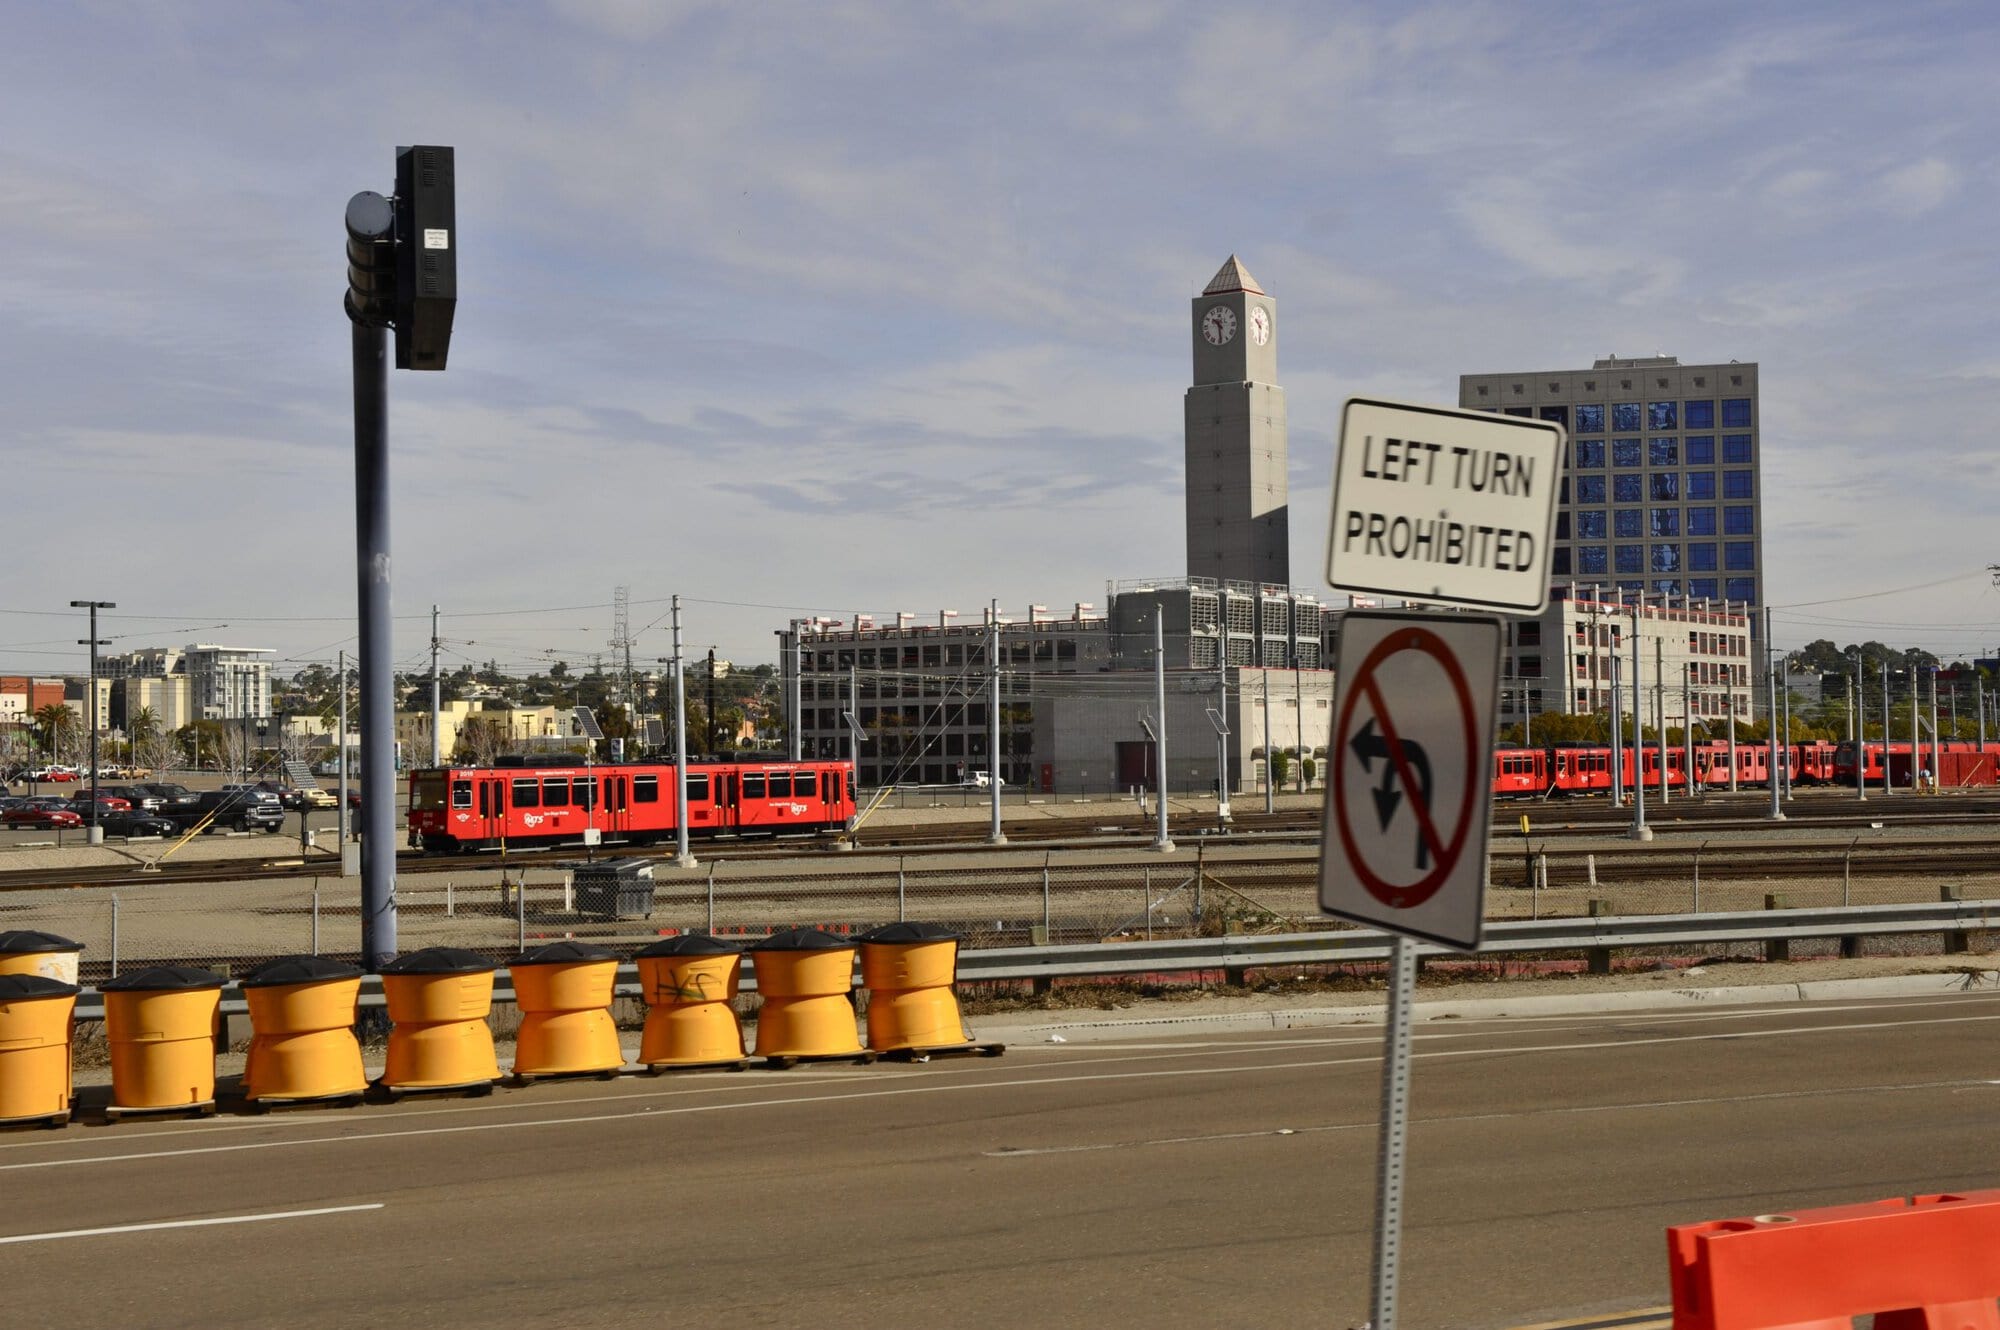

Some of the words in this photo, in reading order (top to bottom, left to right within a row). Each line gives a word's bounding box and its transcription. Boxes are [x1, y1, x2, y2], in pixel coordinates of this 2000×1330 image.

[1361, 435, 1443, 486] LEFT
[1451, 446, 1536, 498] TURN
[1343, 510, 1536, 573] PROHIBITED
